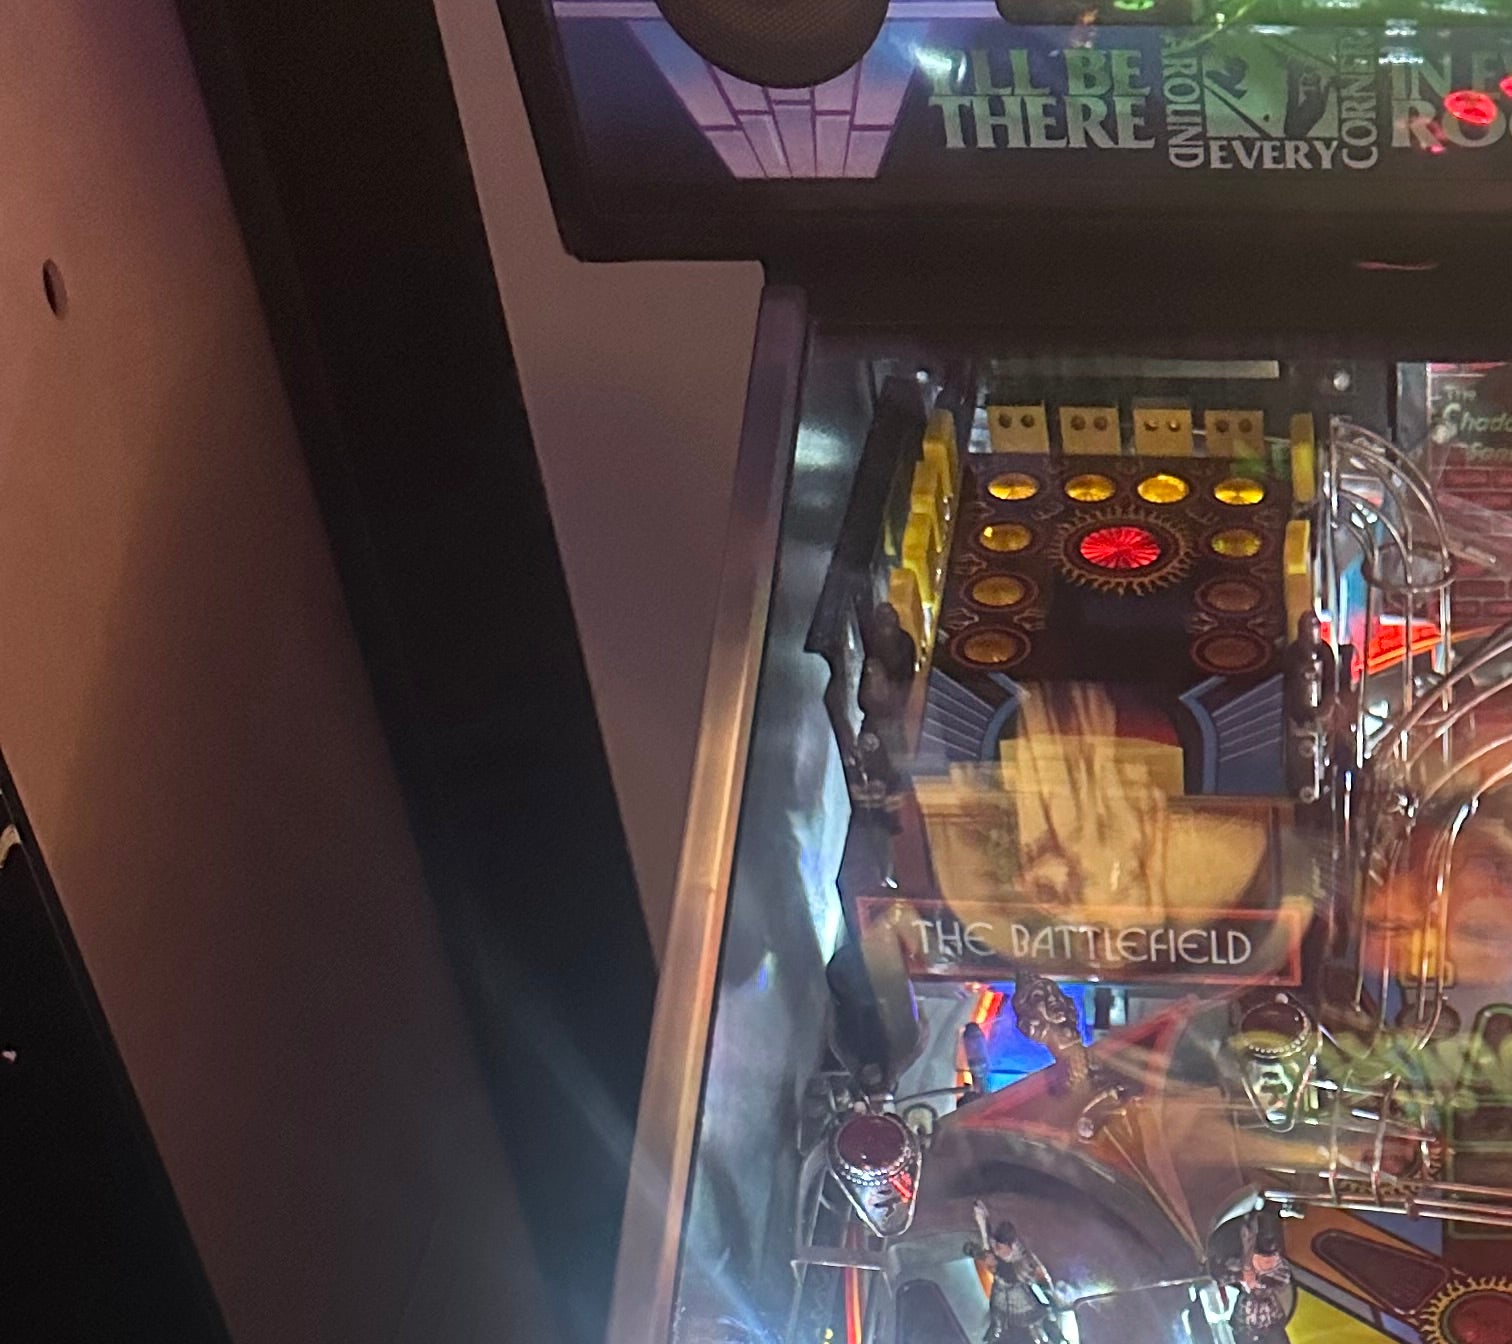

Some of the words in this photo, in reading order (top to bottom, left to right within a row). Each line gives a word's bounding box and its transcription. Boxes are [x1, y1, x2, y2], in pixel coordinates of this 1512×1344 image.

[1065, 47, 1151, 96] BE
[1391, 54, 1451, 100] IN
[928, 97, 1157, 149] THERE
[1208, 139, 1339, 169] EVERY
[911, 917, 997, 957] THE
[1010, 923, 1252, 966] BATTLEFIELD
